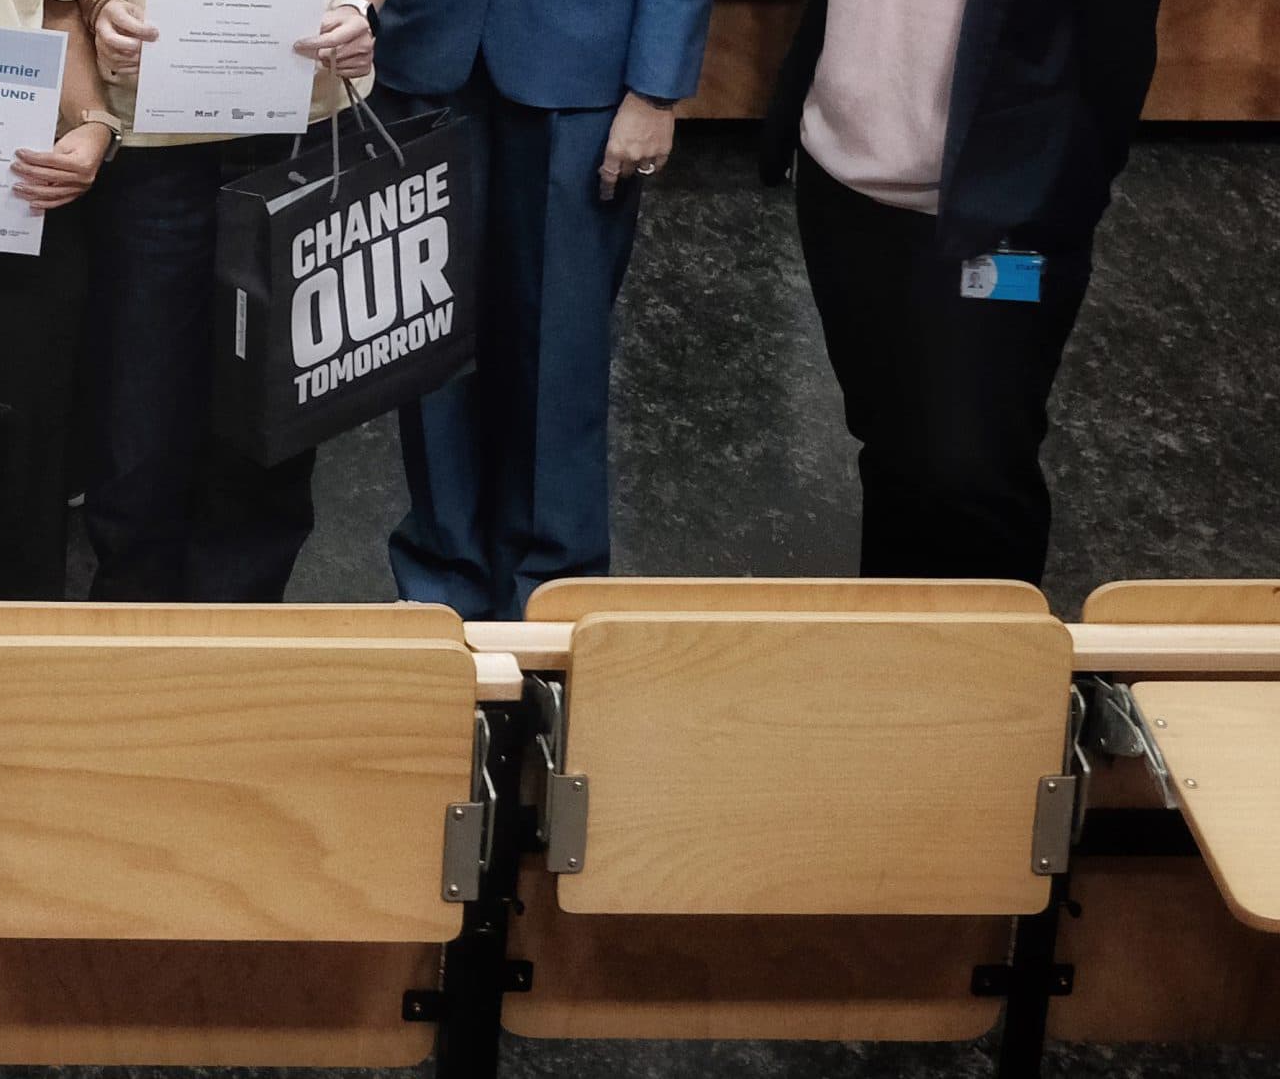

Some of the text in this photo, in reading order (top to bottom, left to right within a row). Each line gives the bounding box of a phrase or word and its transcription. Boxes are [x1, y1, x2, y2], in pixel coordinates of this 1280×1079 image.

[292, 162, 450, 279] CHANGE
[291, 216, 454, 369] OUR
[294, 302, 454, 405] TOMORROW
